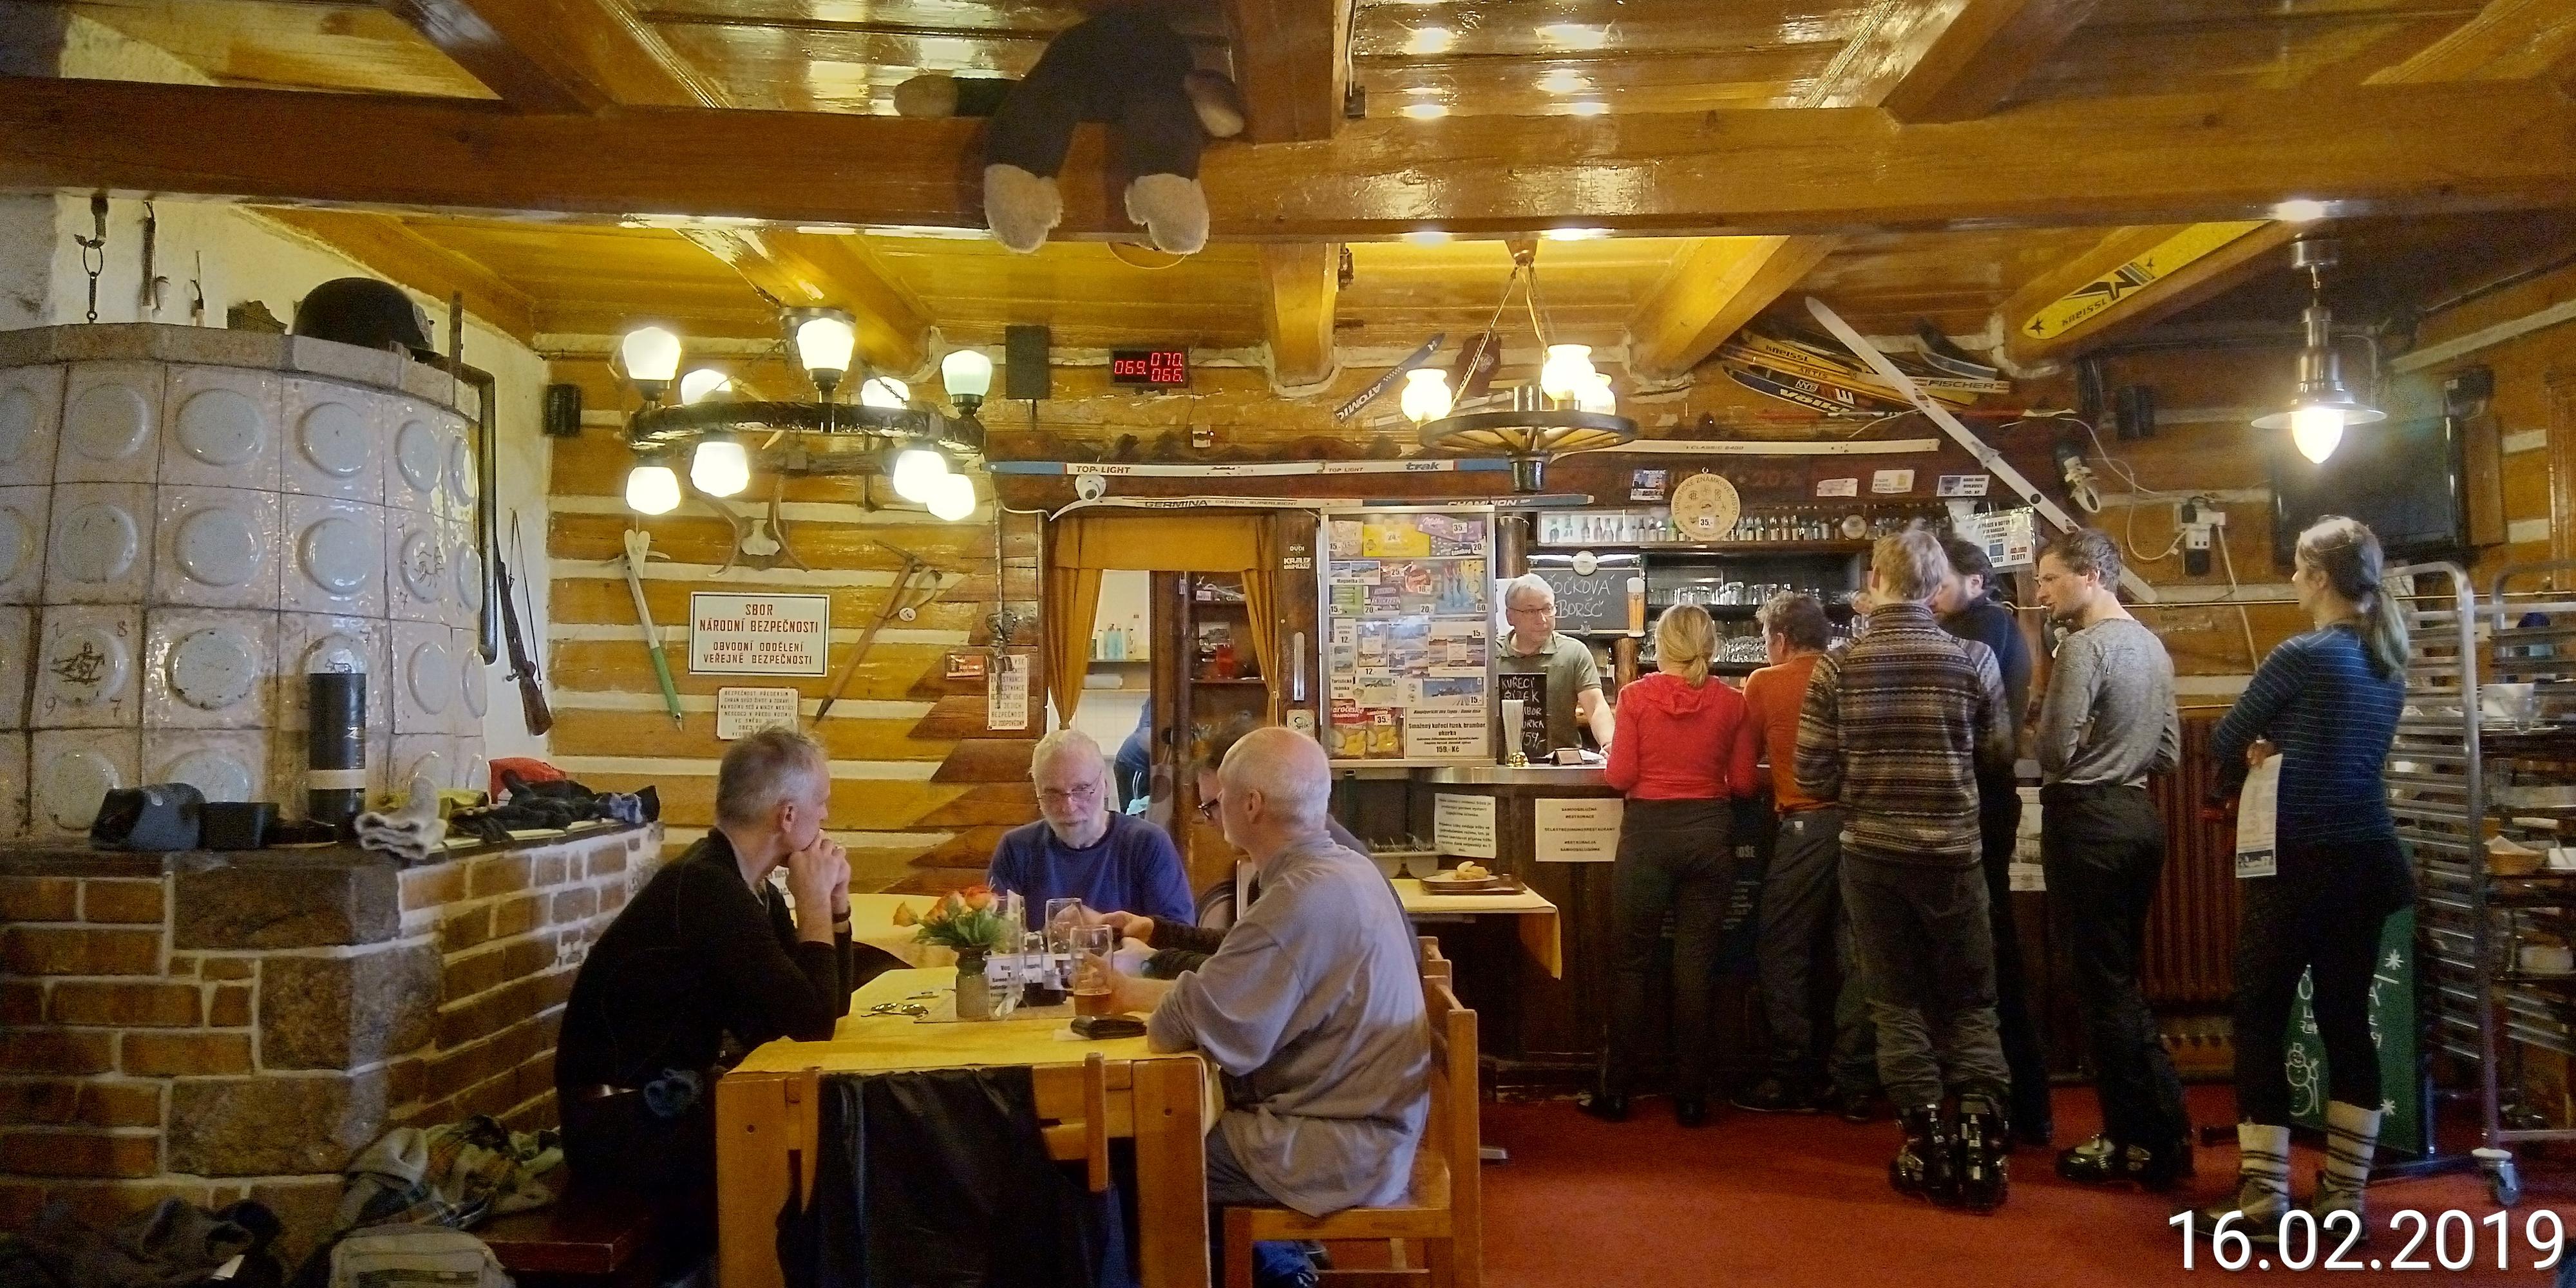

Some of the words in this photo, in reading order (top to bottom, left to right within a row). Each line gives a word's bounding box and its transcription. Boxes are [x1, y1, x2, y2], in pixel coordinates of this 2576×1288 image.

[1929, 379, 1994, 389] FISCHER
[1336, 382, 1381, 421] ATOMIC
[1405, 462, 1440, 471] trak
[1144, 500, 1208, 508] GERMINA
[745, 604, 773, 616] SBOR
[1555, 598, 1604, 619] BORŠČ
[699, 618, 746, 632] NÁRODNÍ
[750, 619, 819, 633] BEZPEČNOSTI
[713, 640, 753, 651] OBVODNÍ
[759, 641, 804, 652] ODDĚLENÍ
[704, 653, 743, 664] VEŘEJNÉ
[752, 654, 812, 665] BEZPEČNOSTI
[1502, 676, 1535, 689] KUŘECÍ
[1523, 720, 1544, 729] URKA
